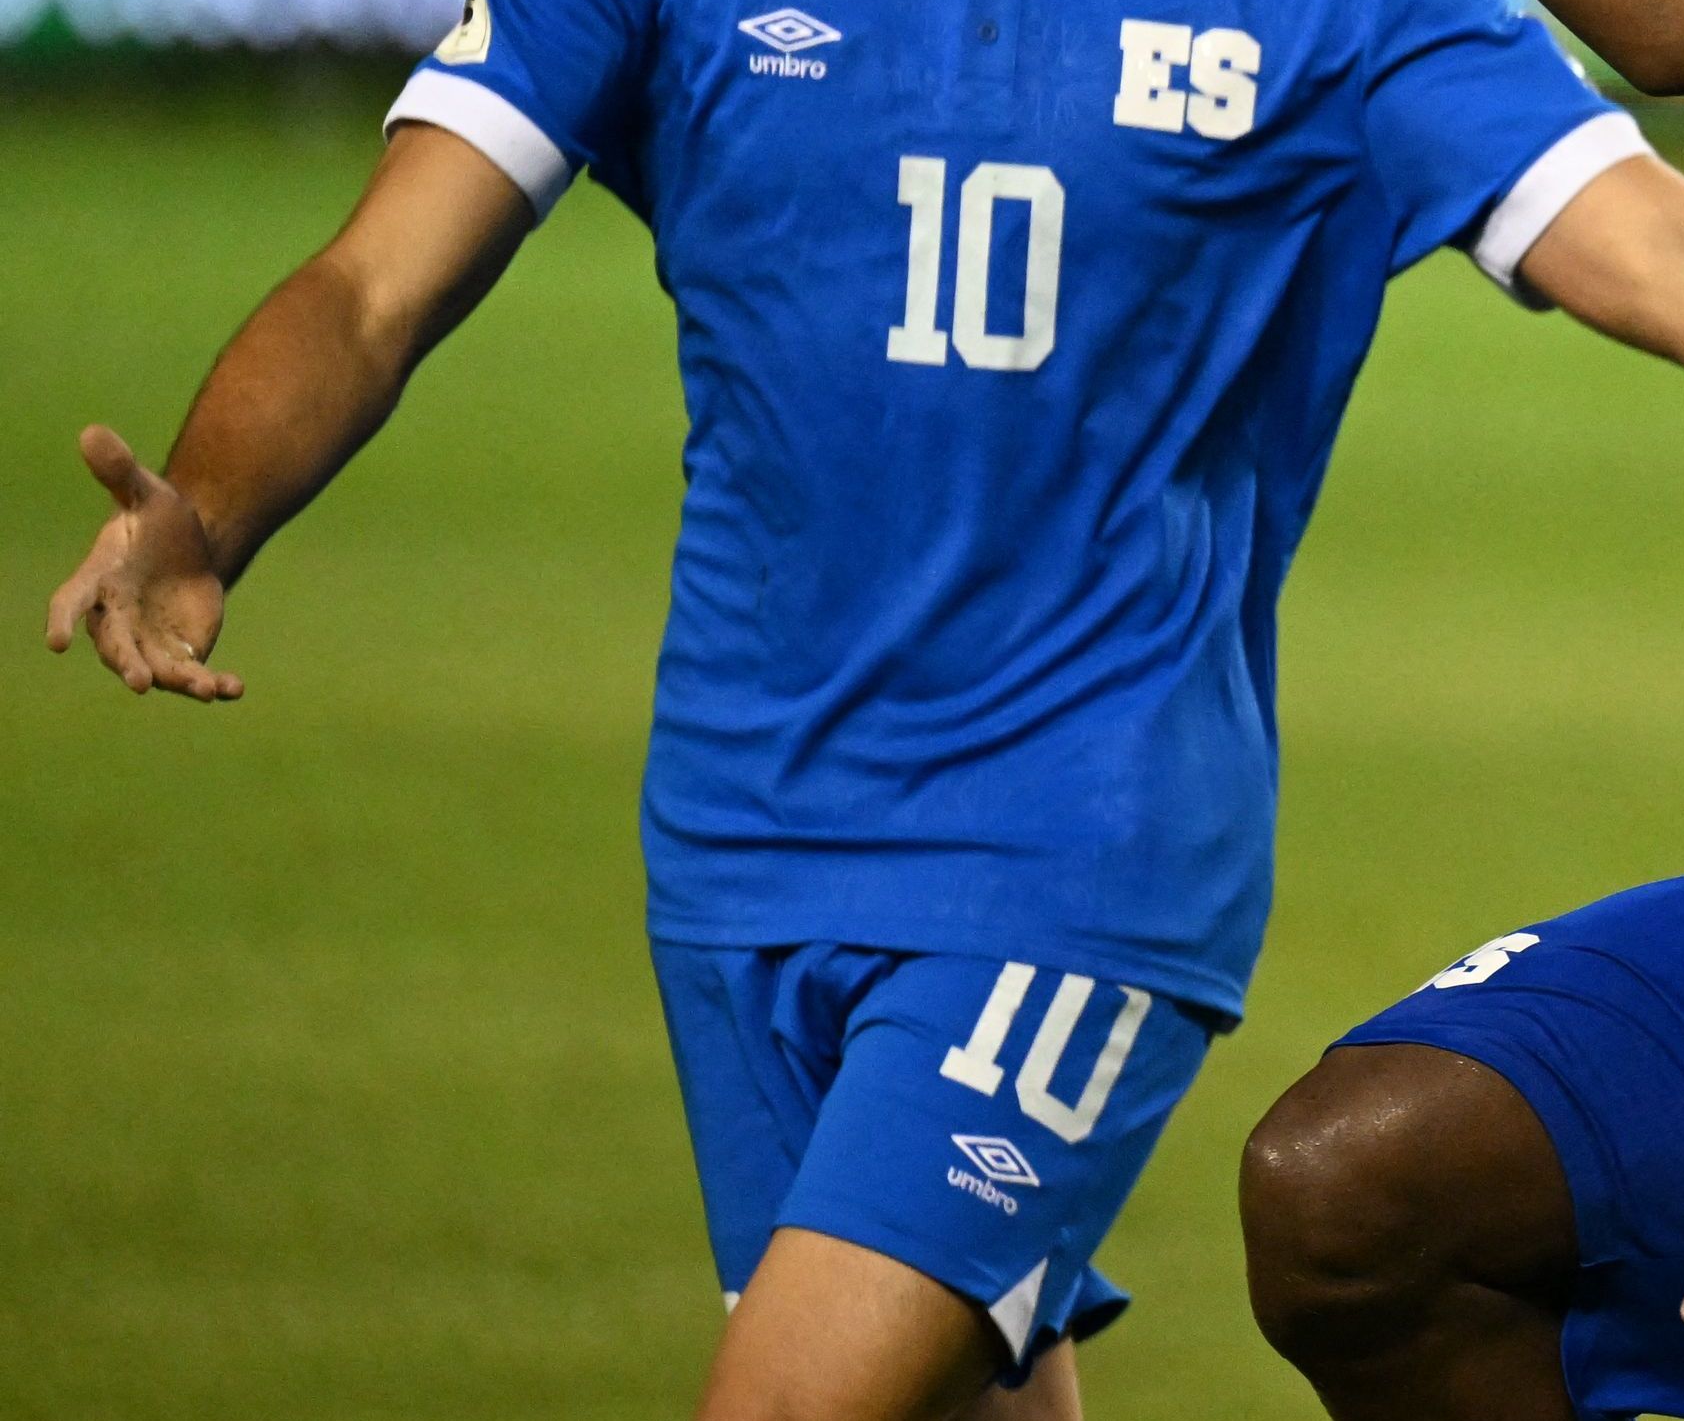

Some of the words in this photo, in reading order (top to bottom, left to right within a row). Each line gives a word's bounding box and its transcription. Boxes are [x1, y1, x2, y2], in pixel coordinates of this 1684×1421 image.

[749, 51, 827, 80] umbro
[1113, 18, 1261, 141] ES
[886, 155, 1065, 371] 10
[938, 961, 1153, 1144] 10
[947, 1165, 1018, 1217] umbro
